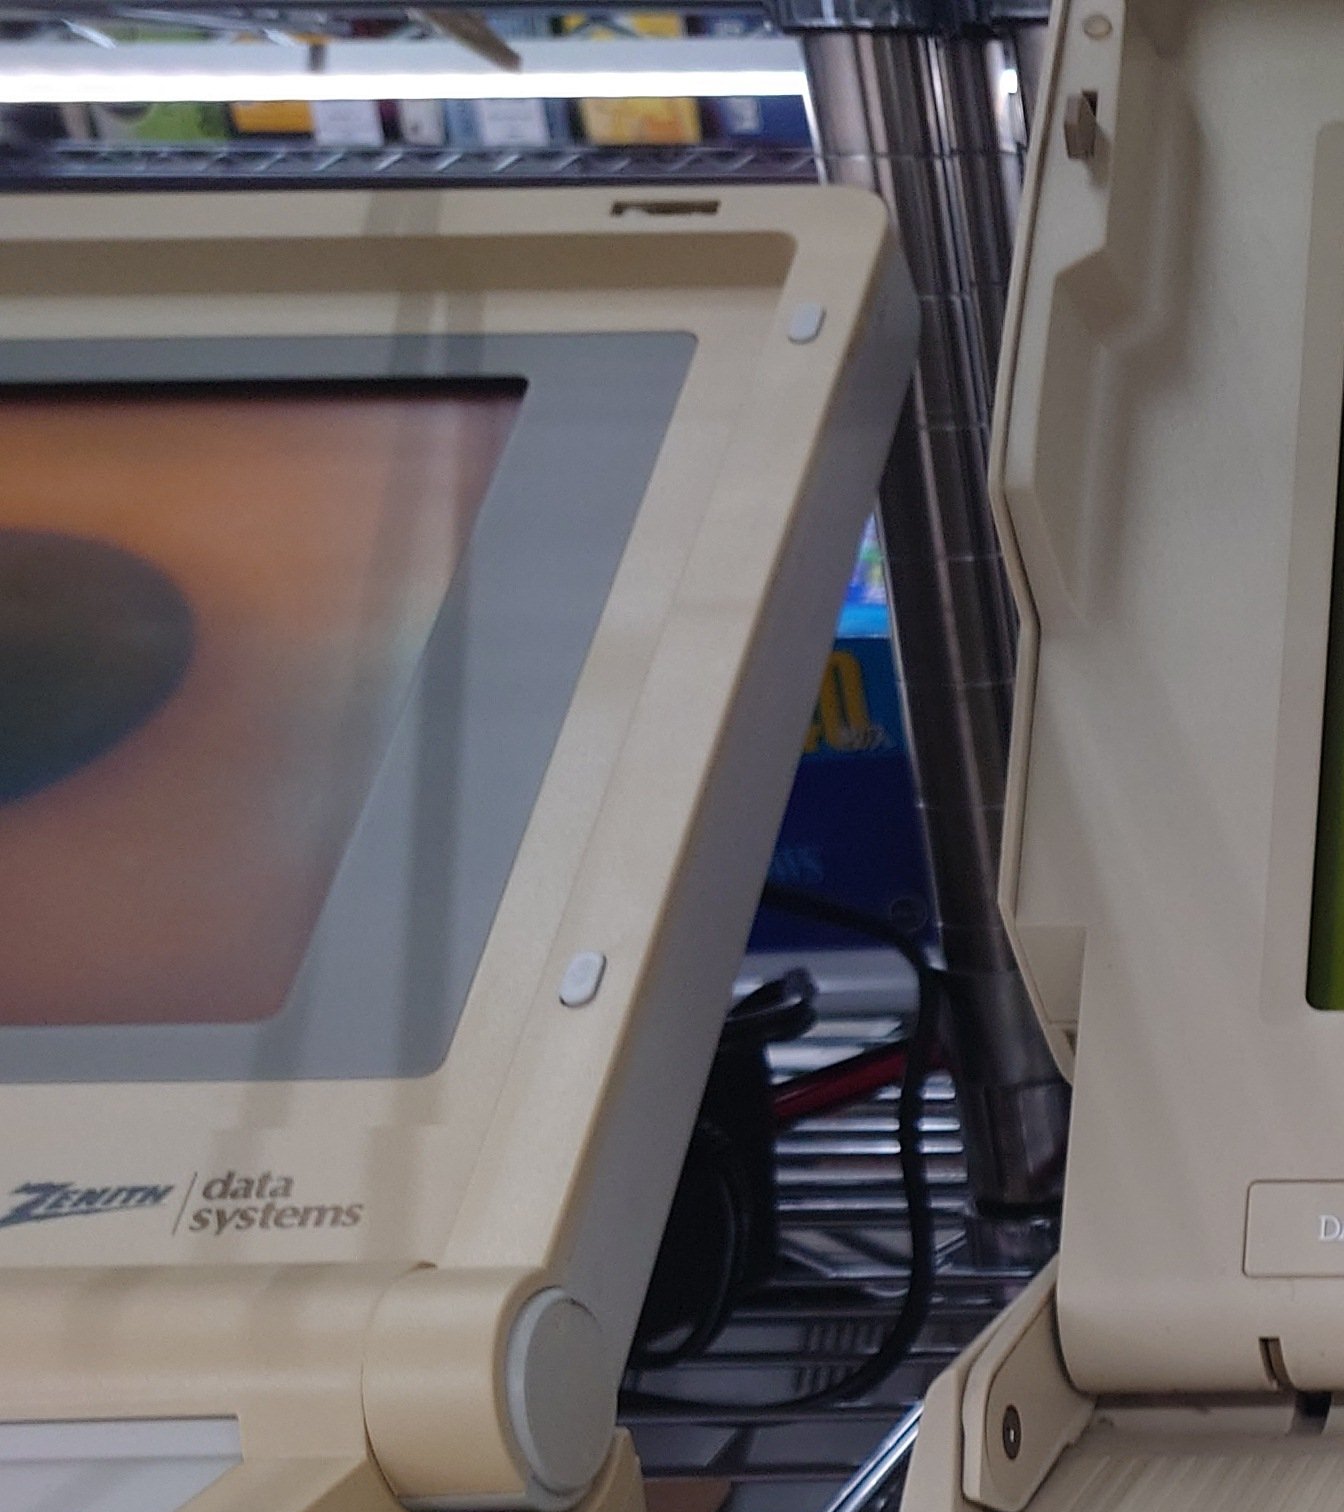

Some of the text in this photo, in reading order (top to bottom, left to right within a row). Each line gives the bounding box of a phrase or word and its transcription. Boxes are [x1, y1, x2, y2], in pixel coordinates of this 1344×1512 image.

[202, 1171, 294, 1201] data
[0, 1182, 174, 1227] ZENITH
[189, 1202, 364, 1236] systems
